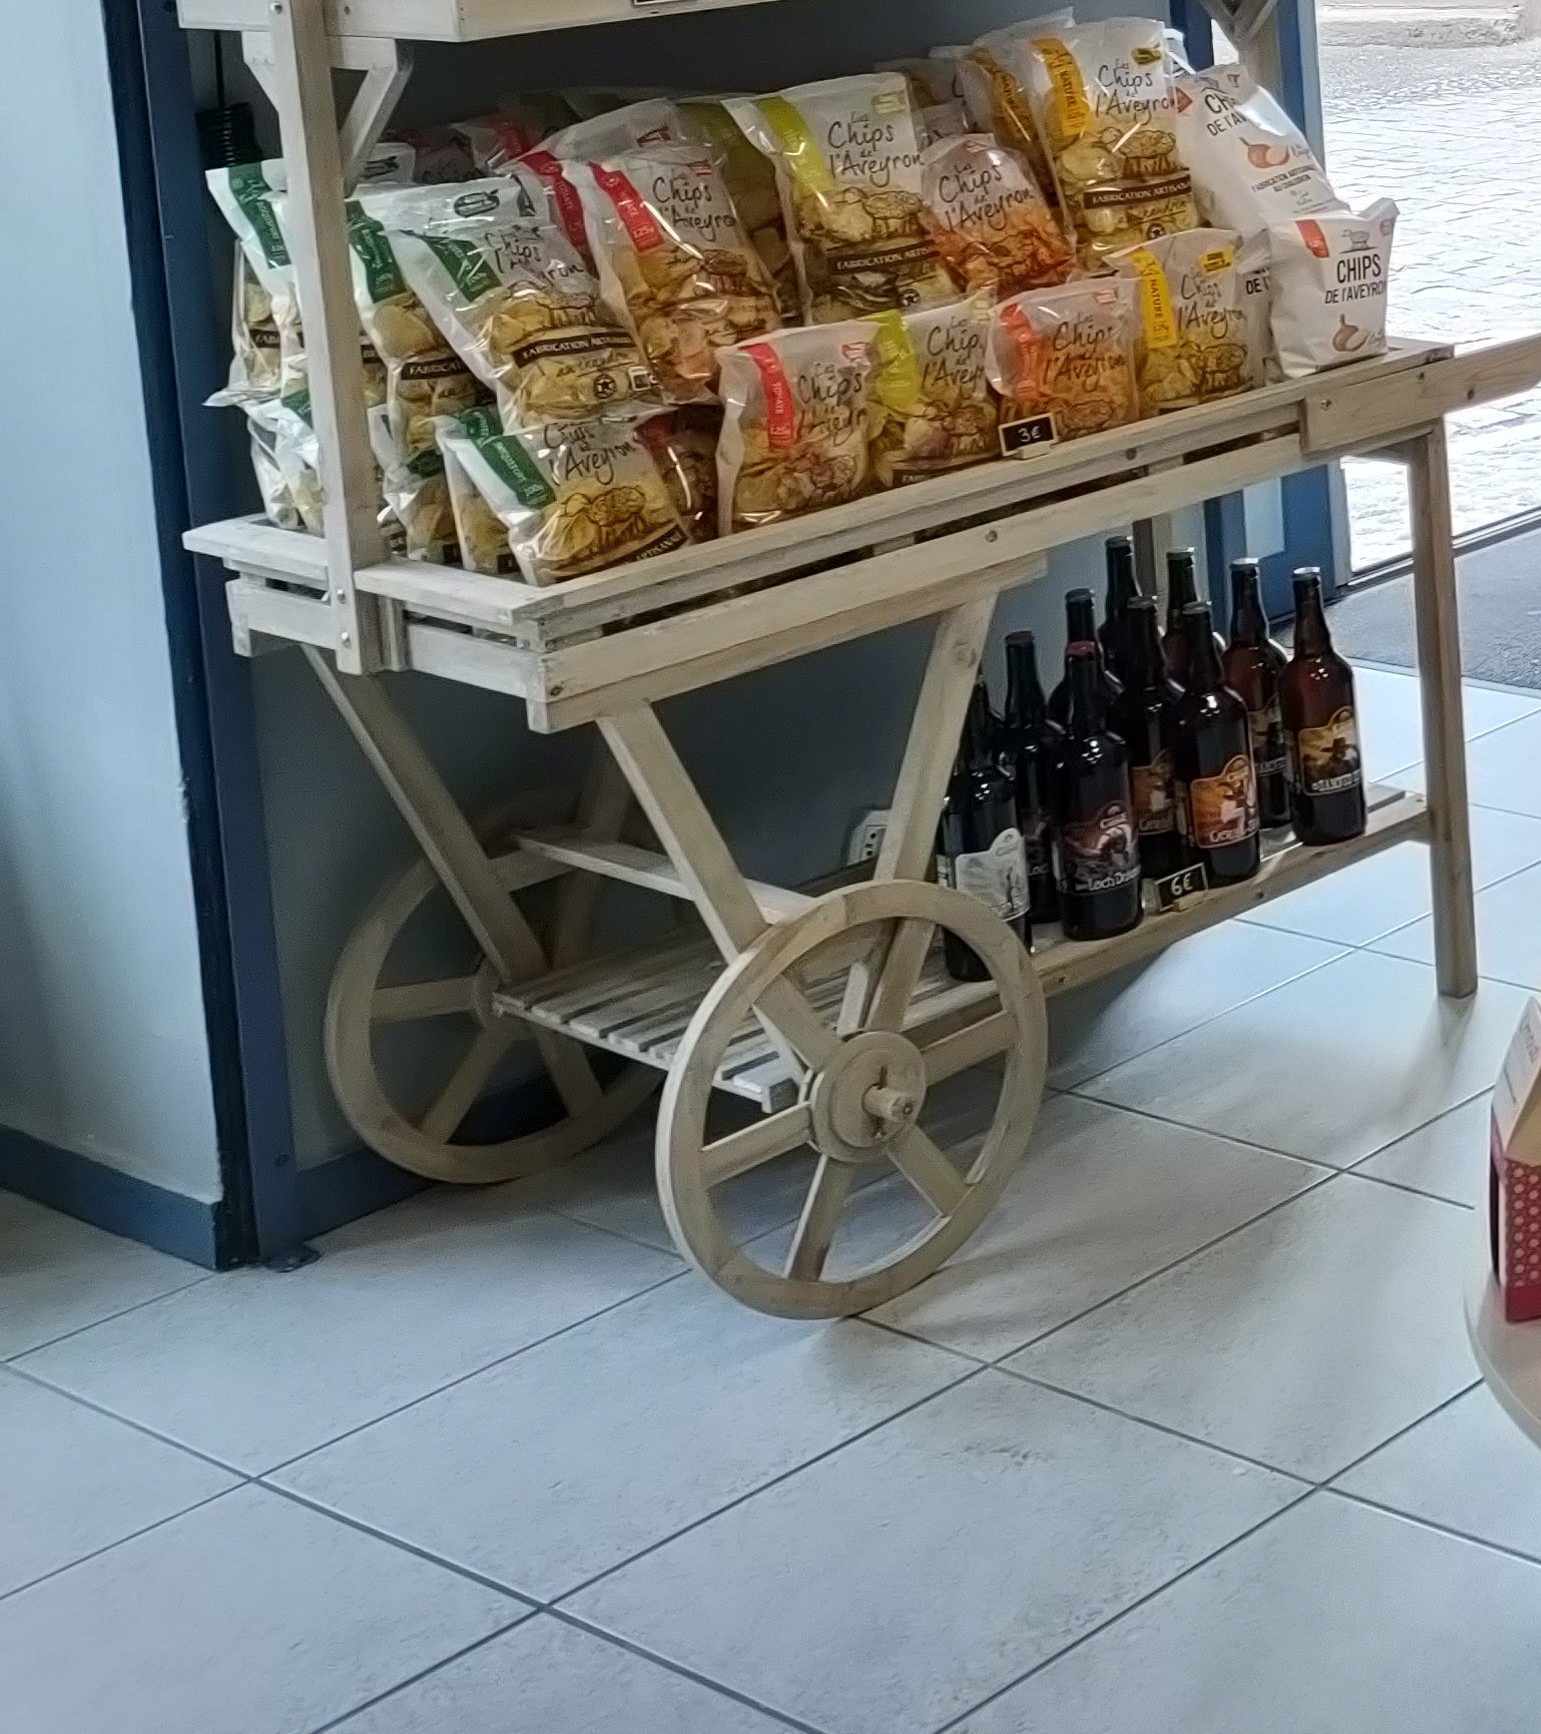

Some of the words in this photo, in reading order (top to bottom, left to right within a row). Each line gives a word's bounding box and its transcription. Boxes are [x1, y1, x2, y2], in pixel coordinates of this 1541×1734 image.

[1060, 69, 1077, 112] NATURE
[1098, 64, 1153, 88] Chips
[827, 121, 895, 151] Chips
[829, 153, 925, 187] l'Aveyron
[939, 164, 1003, 203] Chips
[653, 177, 712, 211] Chips
[944, 188, 1034, 232] l'Aveyron
[1337, 254, 1381, 284] CHIPS
[1149, 278, 1165, 323] NATURE
[1246, 280, 1260, 295] DE
[1325, 290, 1339, 304] DE
[800, 372, 863, 405] Chips
[1019, 426, 1041, 443] 3€
[1171, 875, 1192, 895] 6€
